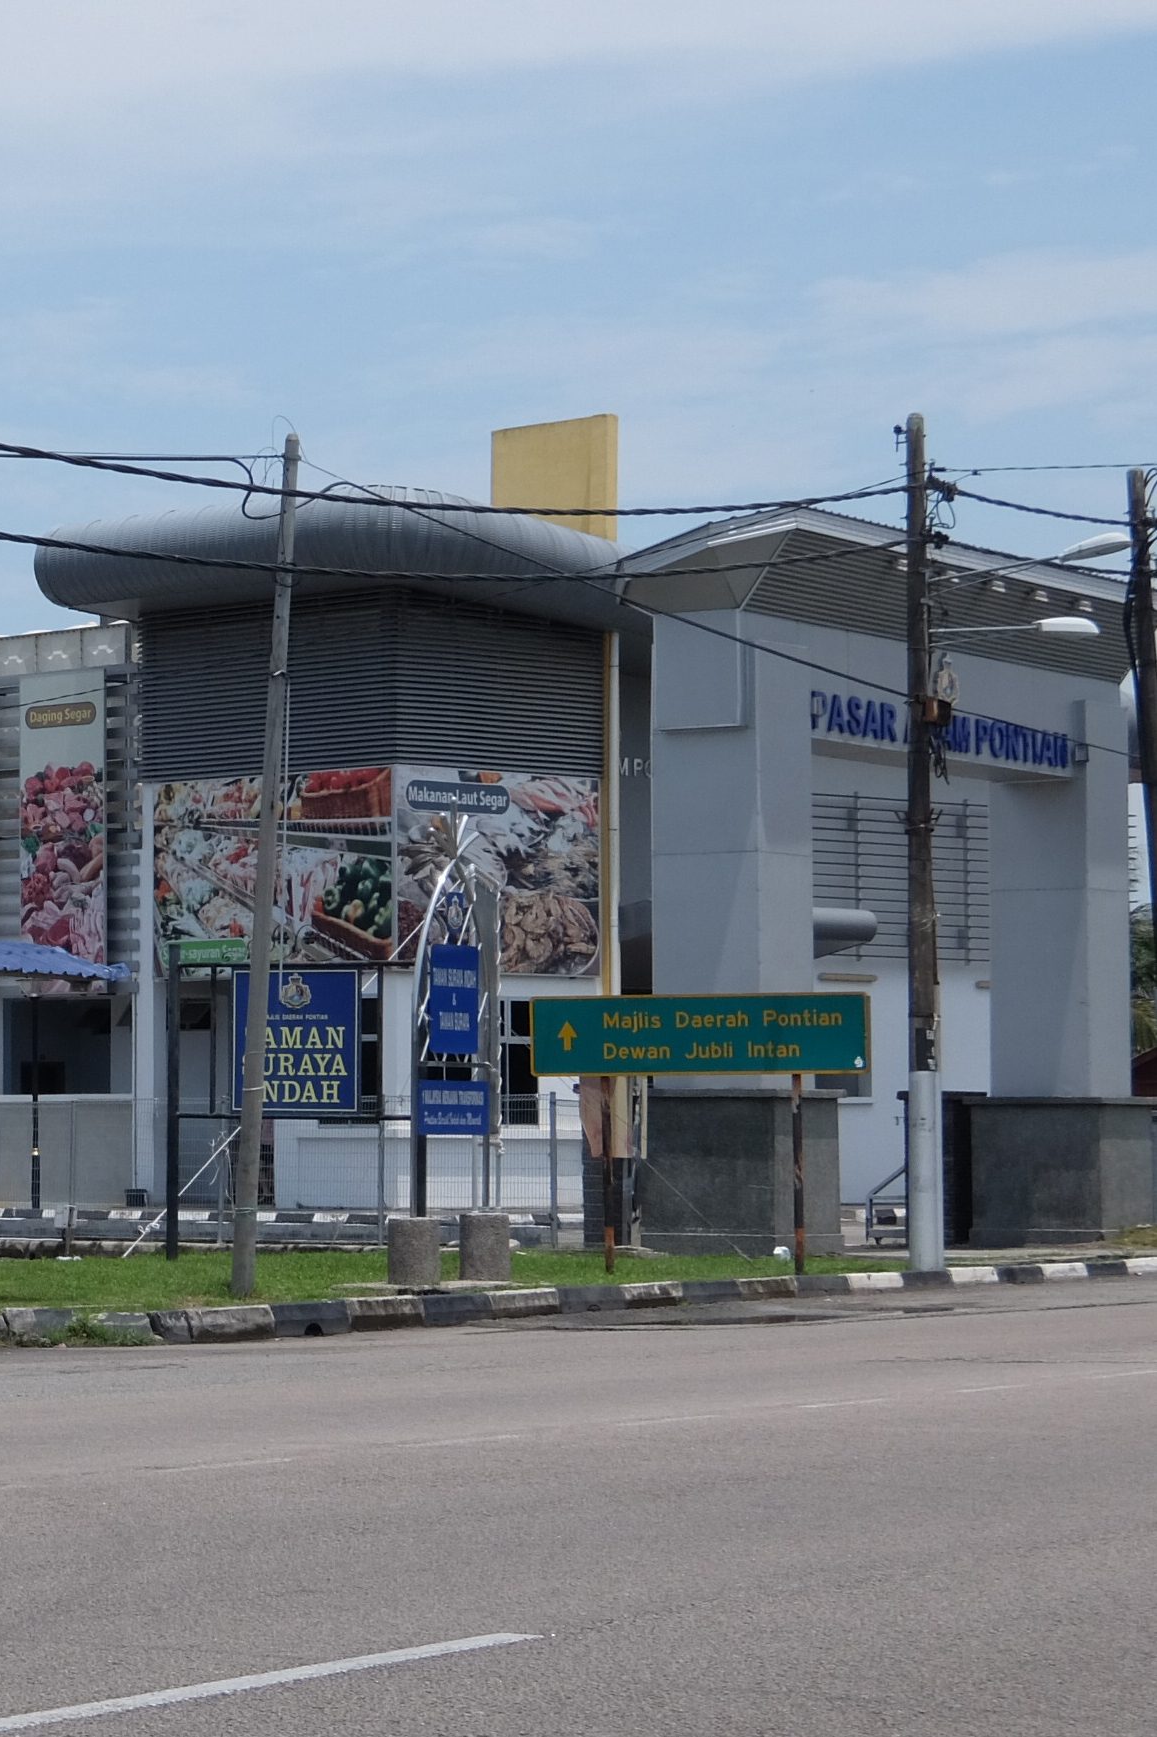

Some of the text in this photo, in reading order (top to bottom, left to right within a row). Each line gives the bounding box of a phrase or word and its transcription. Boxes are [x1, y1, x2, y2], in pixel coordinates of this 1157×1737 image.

[29, 708, 92, 725] Daging Segar
[810, 690, 897, 743] PASAR
[974, 718, 1068, 770] PONTIAN
[408, 785, 508, 811] Makanan Laut Segar
[603, 1009, 842, 1033] Majlis Daerah Pontian
[245, 1026, 346, 1049] AMAN
[603, 1041, 800, 1060] Dewan Jubli Intan
[242, 1053, 348, 1077] URAYA
[262, 1080, 341, 1104] NDAH
